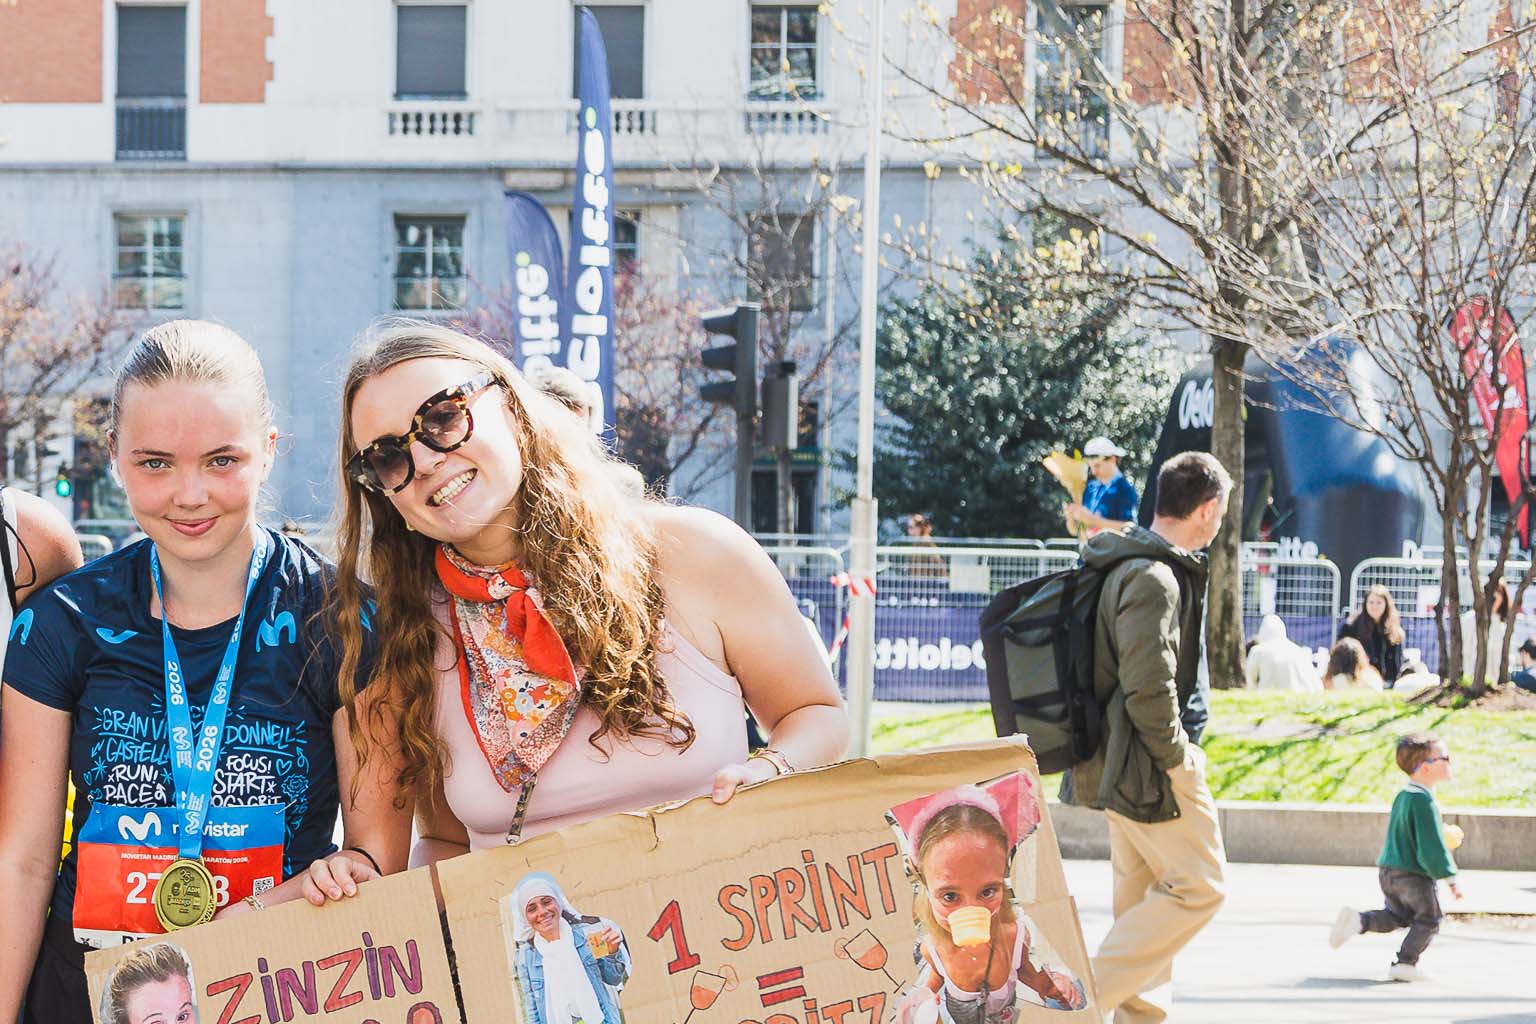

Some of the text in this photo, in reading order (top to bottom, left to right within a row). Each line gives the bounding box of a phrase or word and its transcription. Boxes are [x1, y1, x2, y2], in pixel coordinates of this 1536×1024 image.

[167, 660, 185, 706] 2026
[103, 708, 149, 738] GRAN
[105, 737, 170, 766] CASTELL
[196, 725, 220, 773] 2026
[226, 753, 272, 774] FOCUS!
[103, 783, 154, 804] PACE
[212, 768, 276, 797] START
[647, 898, 701, 975] 1
